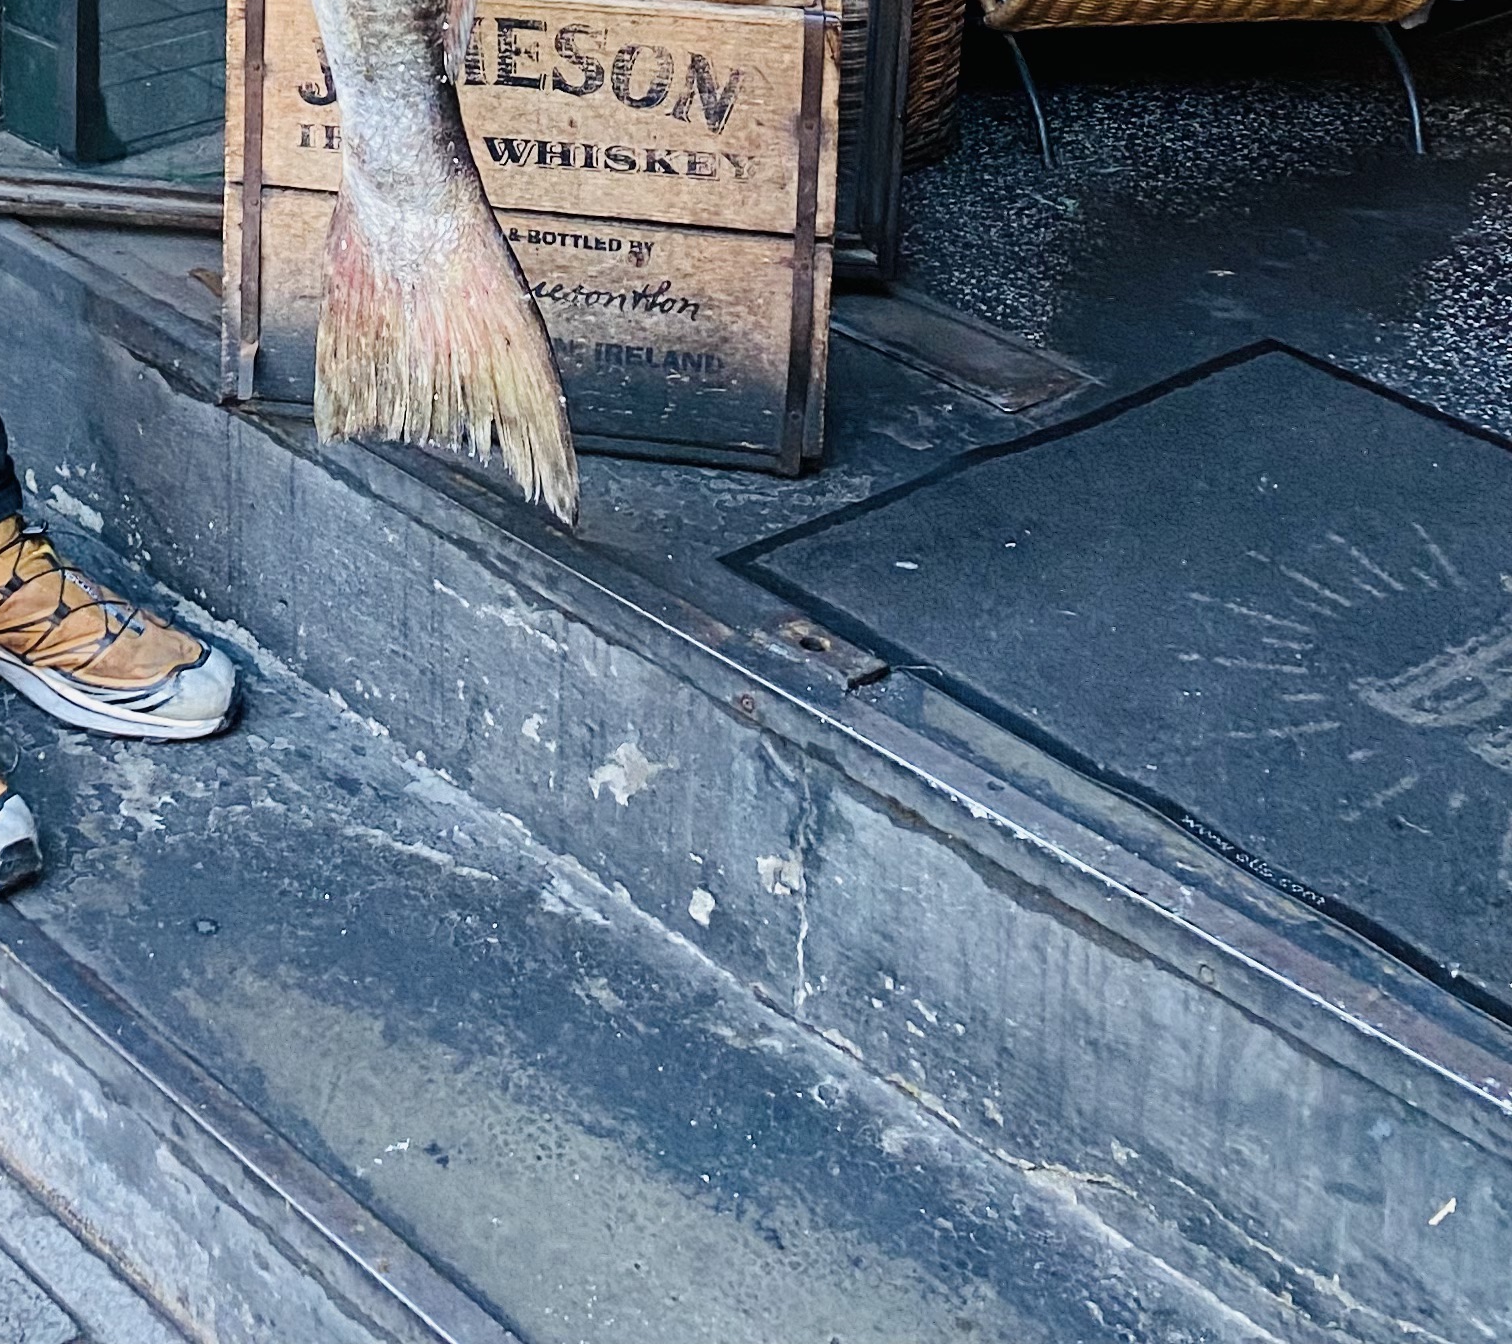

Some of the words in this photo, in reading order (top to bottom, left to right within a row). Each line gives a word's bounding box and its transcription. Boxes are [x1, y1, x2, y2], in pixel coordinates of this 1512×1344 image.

[297, 16, 746, 135] JESON
[482, 136, 757, 184] WHISKEY
[526, 228, 622, 253] BOTTLED
[594, 341, 725, 372] IRELAND
